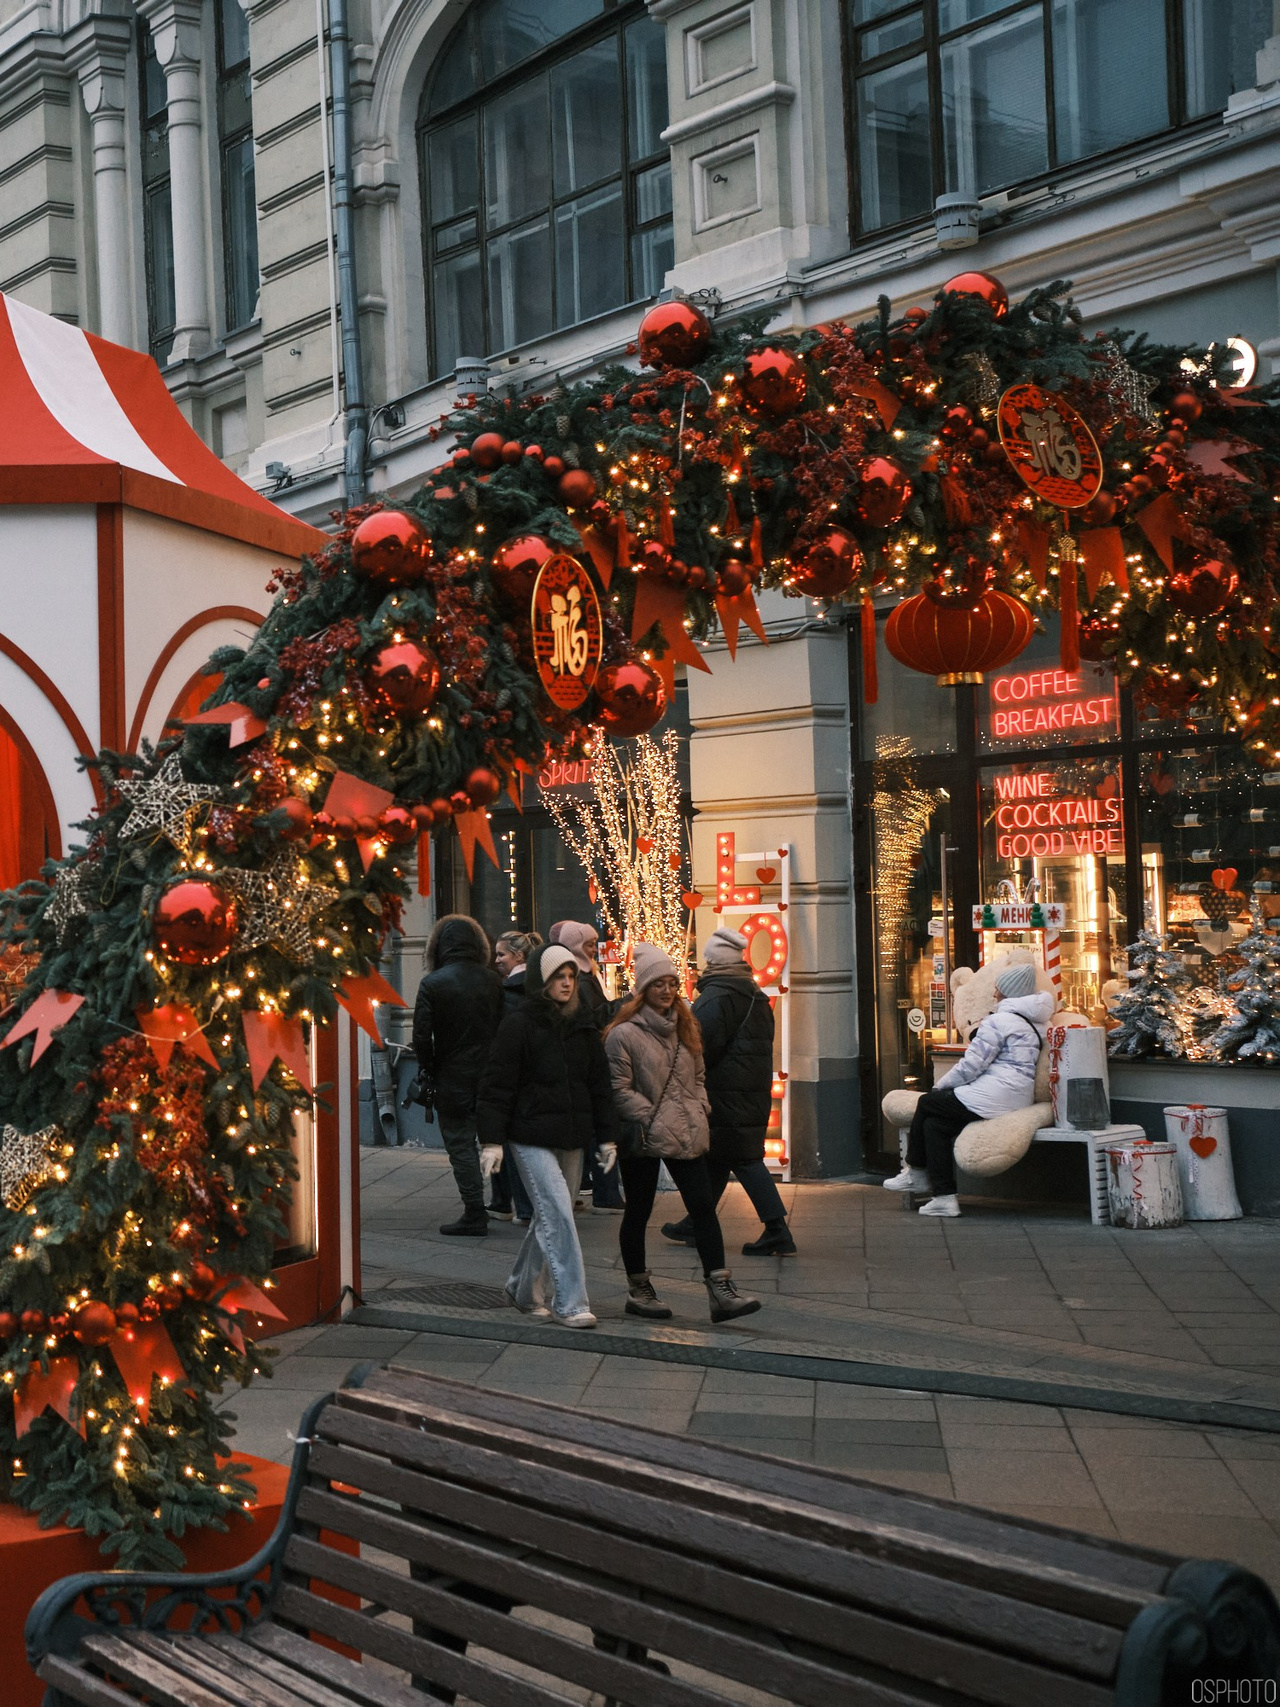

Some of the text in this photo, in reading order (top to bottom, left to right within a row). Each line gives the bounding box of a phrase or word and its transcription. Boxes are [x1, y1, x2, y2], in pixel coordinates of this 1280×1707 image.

[994, 670, 1079, 702] COFFEE
[994, 698, 1113, 735] BREAKFAST
[997, 773, 1050, 798] WINE
[998, 798, 1119, 829] COCKTAILS
[999, 829, 1120, 858] GOOD VIBE
